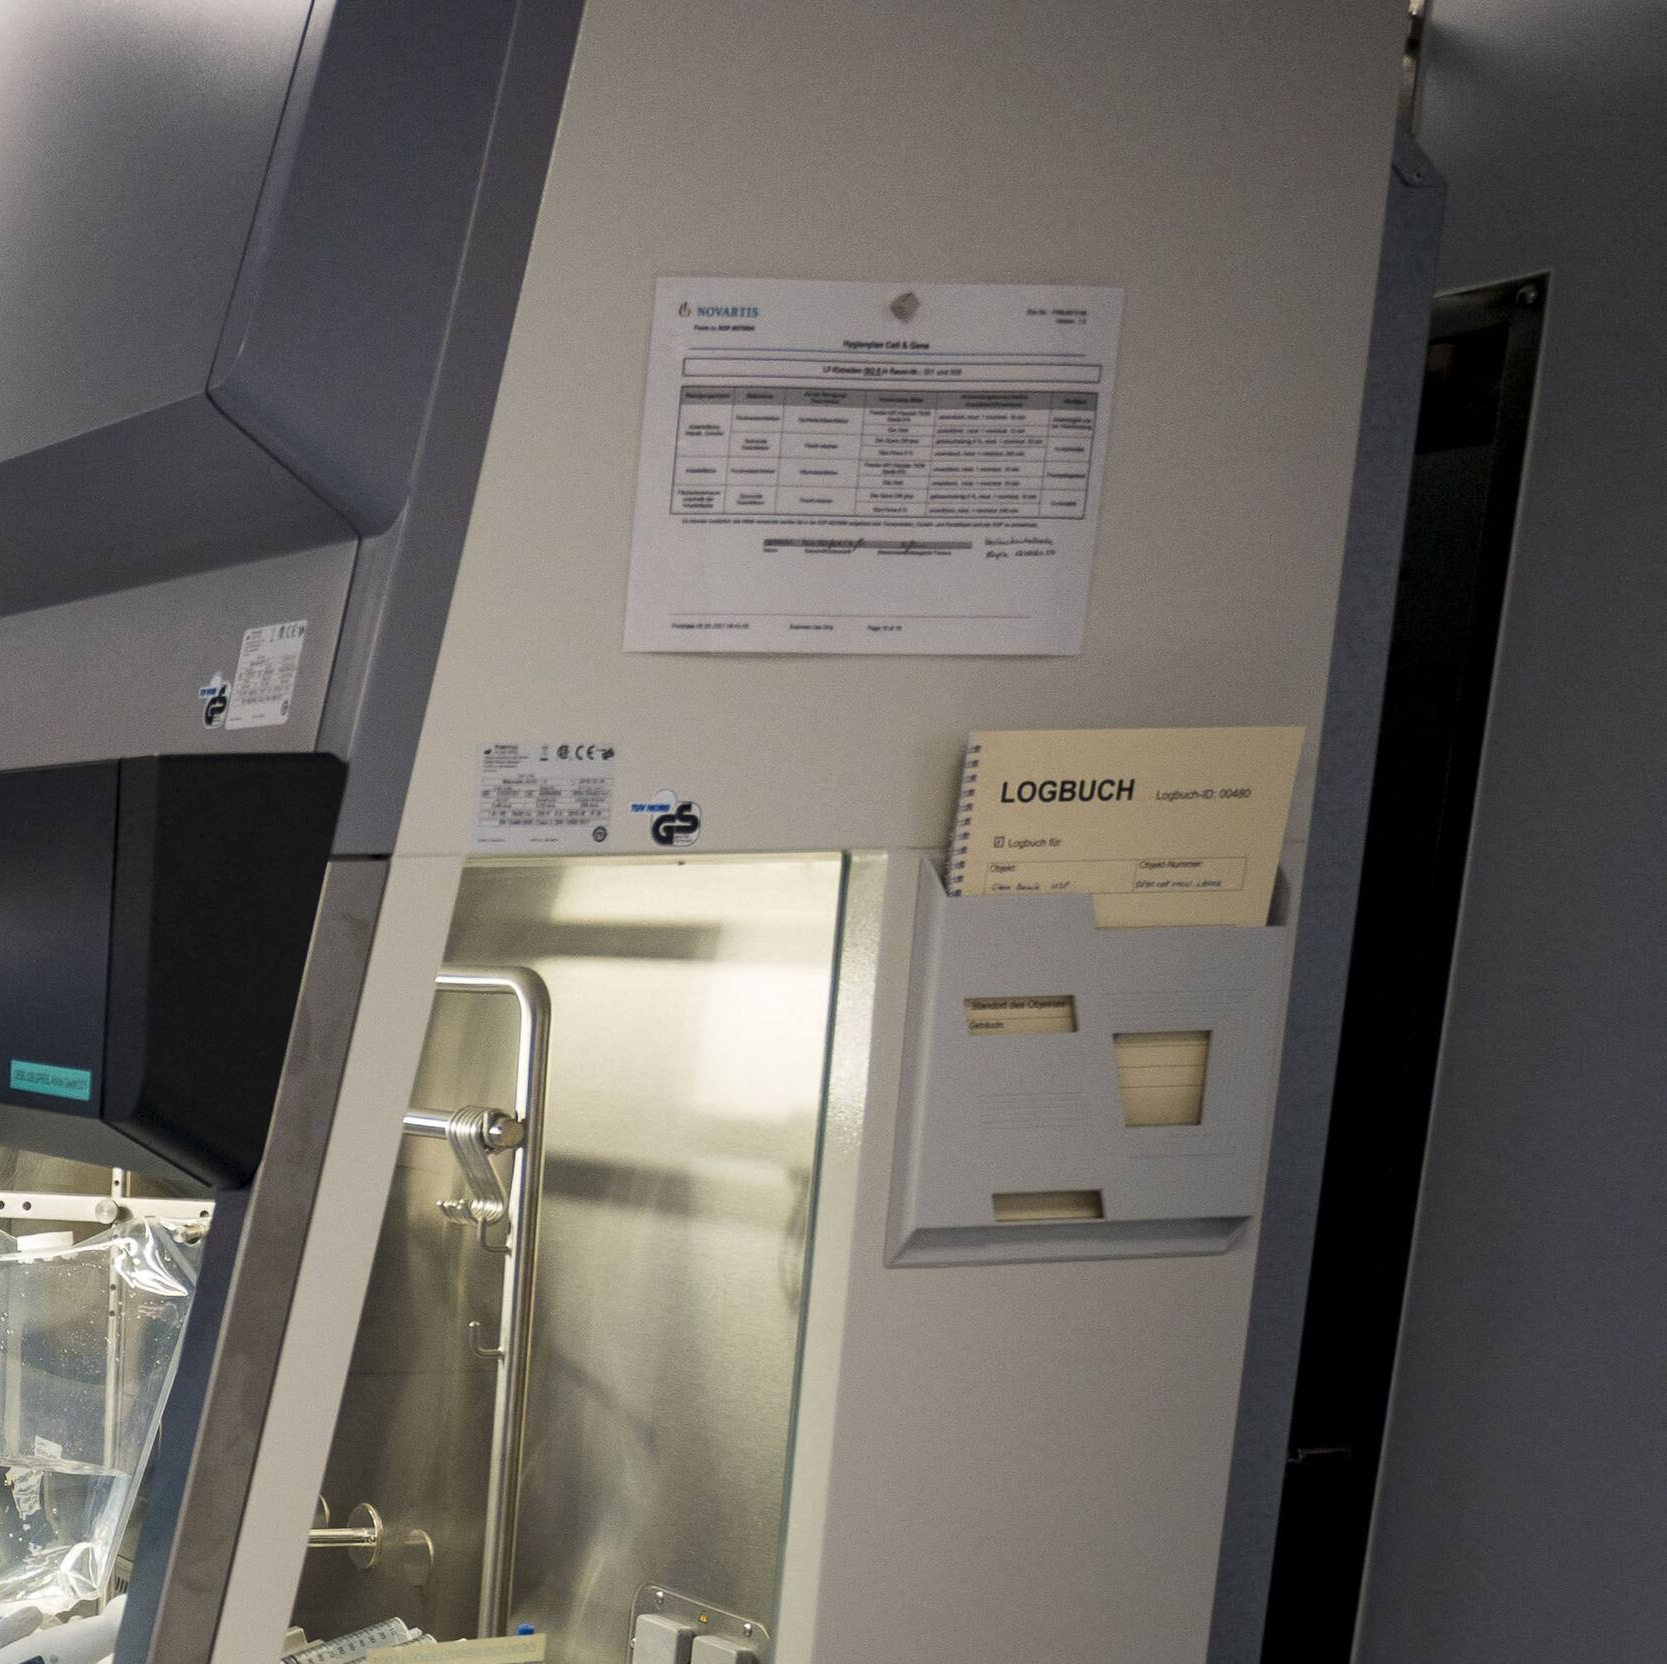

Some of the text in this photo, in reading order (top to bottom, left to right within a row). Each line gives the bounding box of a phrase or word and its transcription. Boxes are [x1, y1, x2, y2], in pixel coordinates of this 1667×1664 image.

[697, 306, 759, 318] NOVARTIS
[1001, 778, 1135, 803] LOGBUCH
[1008, 838, 1046, 849] Logbuch
